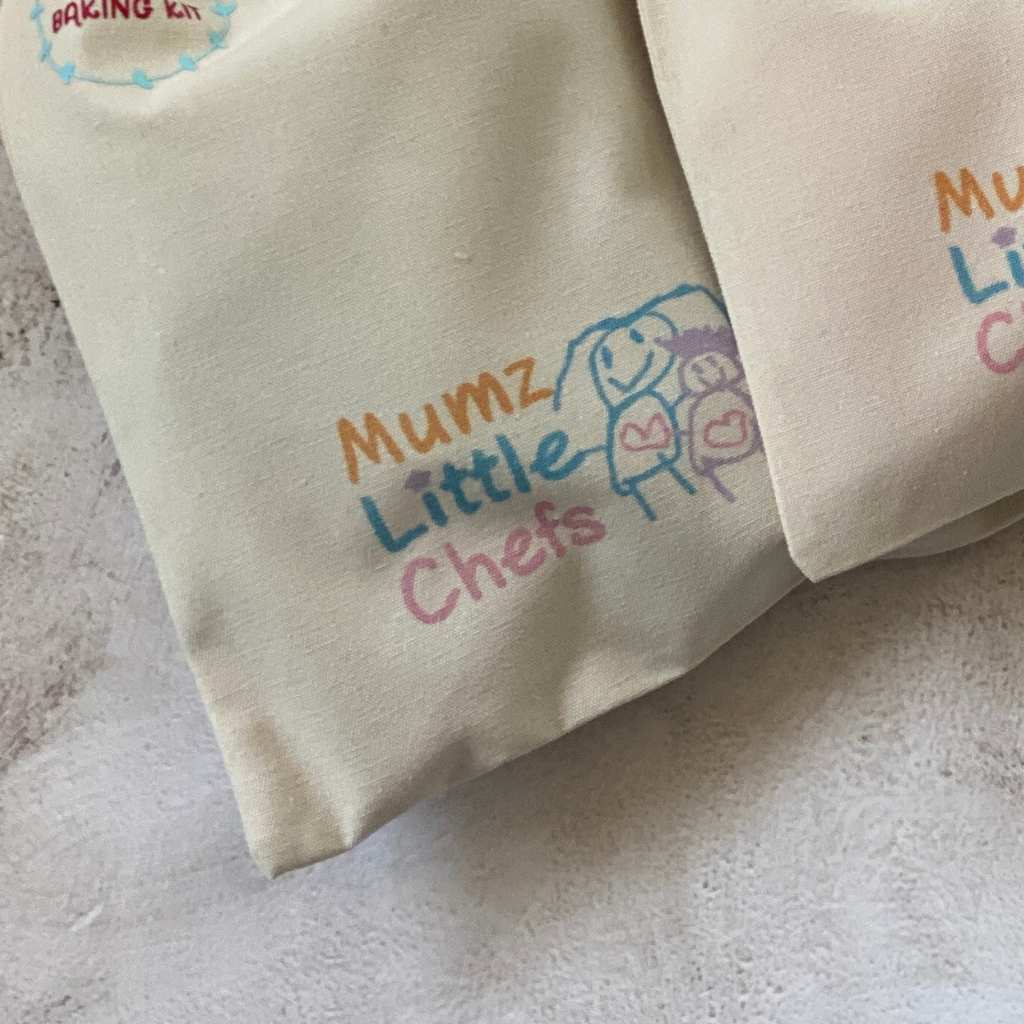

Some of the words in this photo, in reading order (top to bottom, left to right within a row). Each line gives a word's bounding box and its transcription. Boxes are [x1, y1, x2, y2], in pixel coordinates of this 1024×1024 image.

[336, 357, 554, 484] Mumz
[361, 430, 586, 553] Little
[402, 500, 607, 625] Chefs
